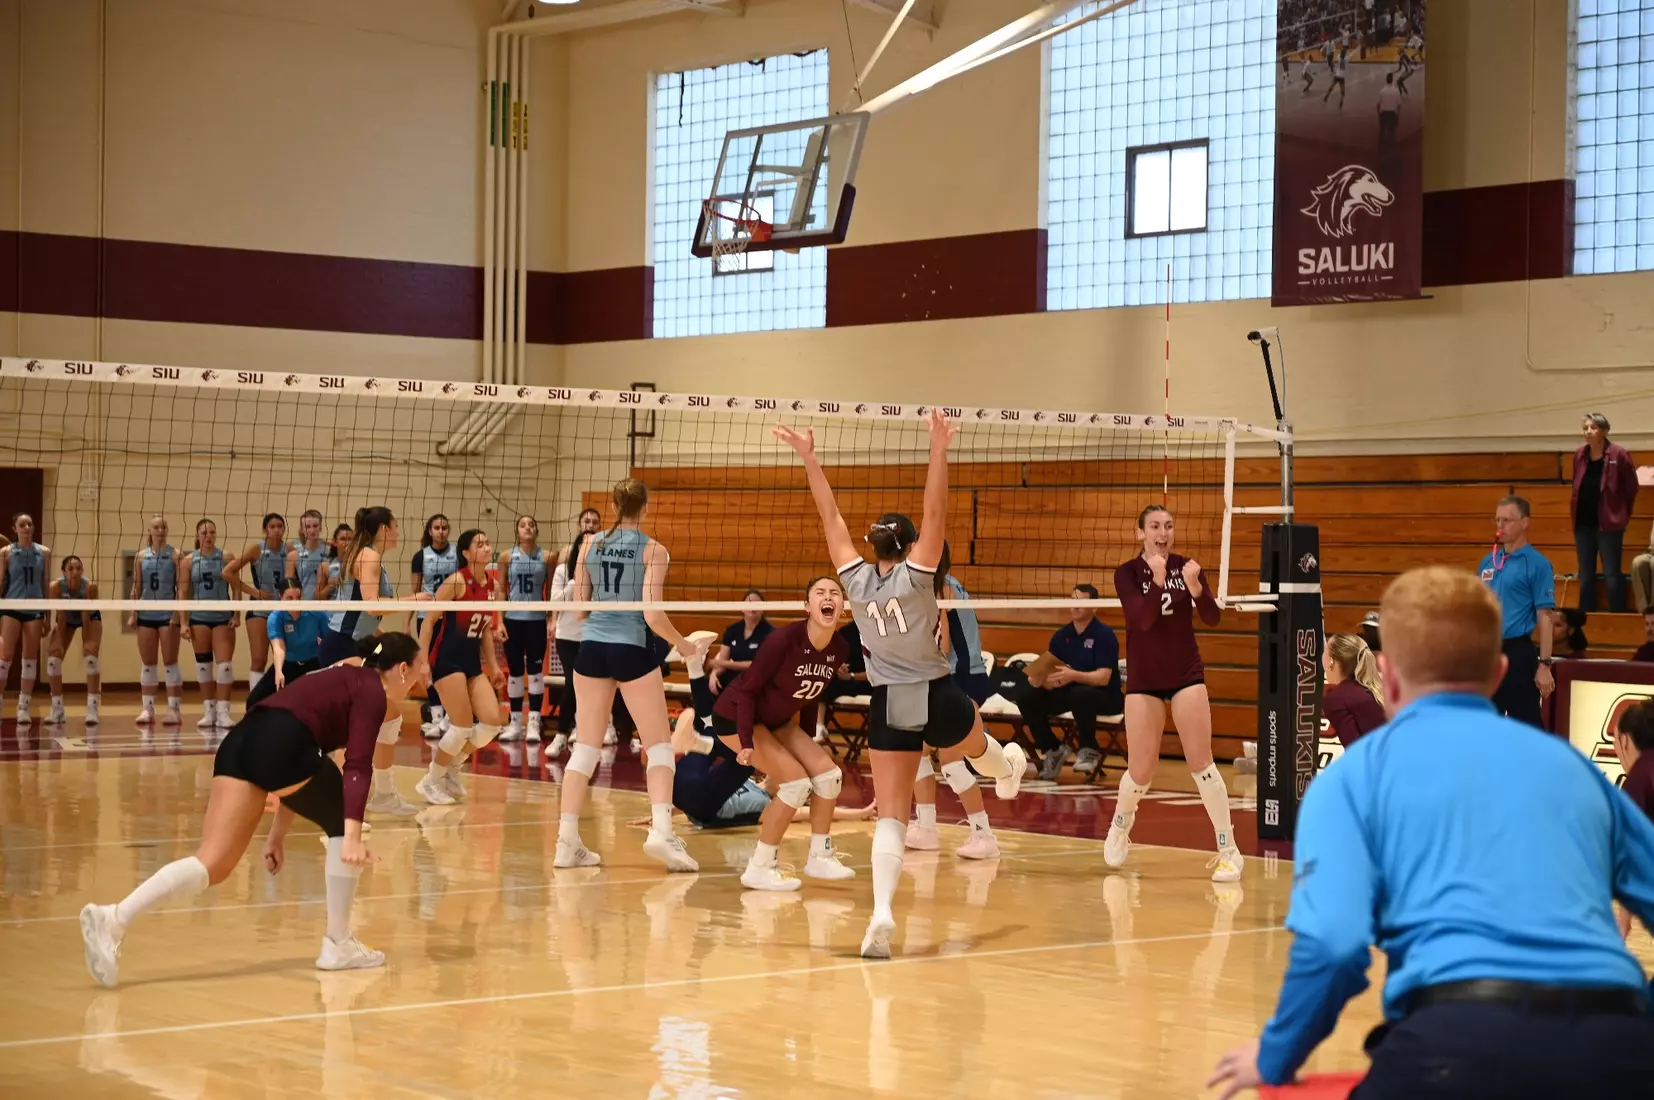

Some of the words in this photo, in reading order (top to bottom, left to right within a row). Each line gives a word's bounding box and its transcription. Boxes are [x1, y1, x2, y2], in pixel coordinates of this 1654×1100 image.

[1298, 242, 1394, 275] SALUKI
[1312, 274, 1379, 286] VOLLEYBALL
[64, 362, 94, 375] SIU
[152, 367, 180, 380] SIU
[237, 372, 264, 384] SIU
[319, 376, 345, 389] SIU
[398, 380, 423, 392] SIU
[474, 384, 498, 396] SIU
[548, 388, 572, 400] SIU
[618, 392, 642, 404] SIU
[687, 395, 710, 407] SIU
[754, 399, 777, 410] SIU
[818, 402, 840, 413] SIU
[881, 405, 902, 416] SIU
[942, 407, 962, 418] SIU
[1000, 410, 1020, 421] SIU
[1057, 412, 1077, 423] SIU
[1113, 415, 1131, 425] SIU
[1167, 417, 1184, 428] SIU
[596, 547, 635, 559] FLAMES
[150, 572, 159, 591] 6
[202, 571, 214, 591] 5
[602, 561, 625, 594] 17
[866, 596, 909, 637] 11
[1161, 592, 1174, 616] 2
[467, 612, 493, 638] 27
[794, 662, 834, 680] SALUKIS
[792, 679, 825, 700] 20
[1295, 628, 1317, 801] SALUKIS
[1269, 711, 1277, 744] sports
